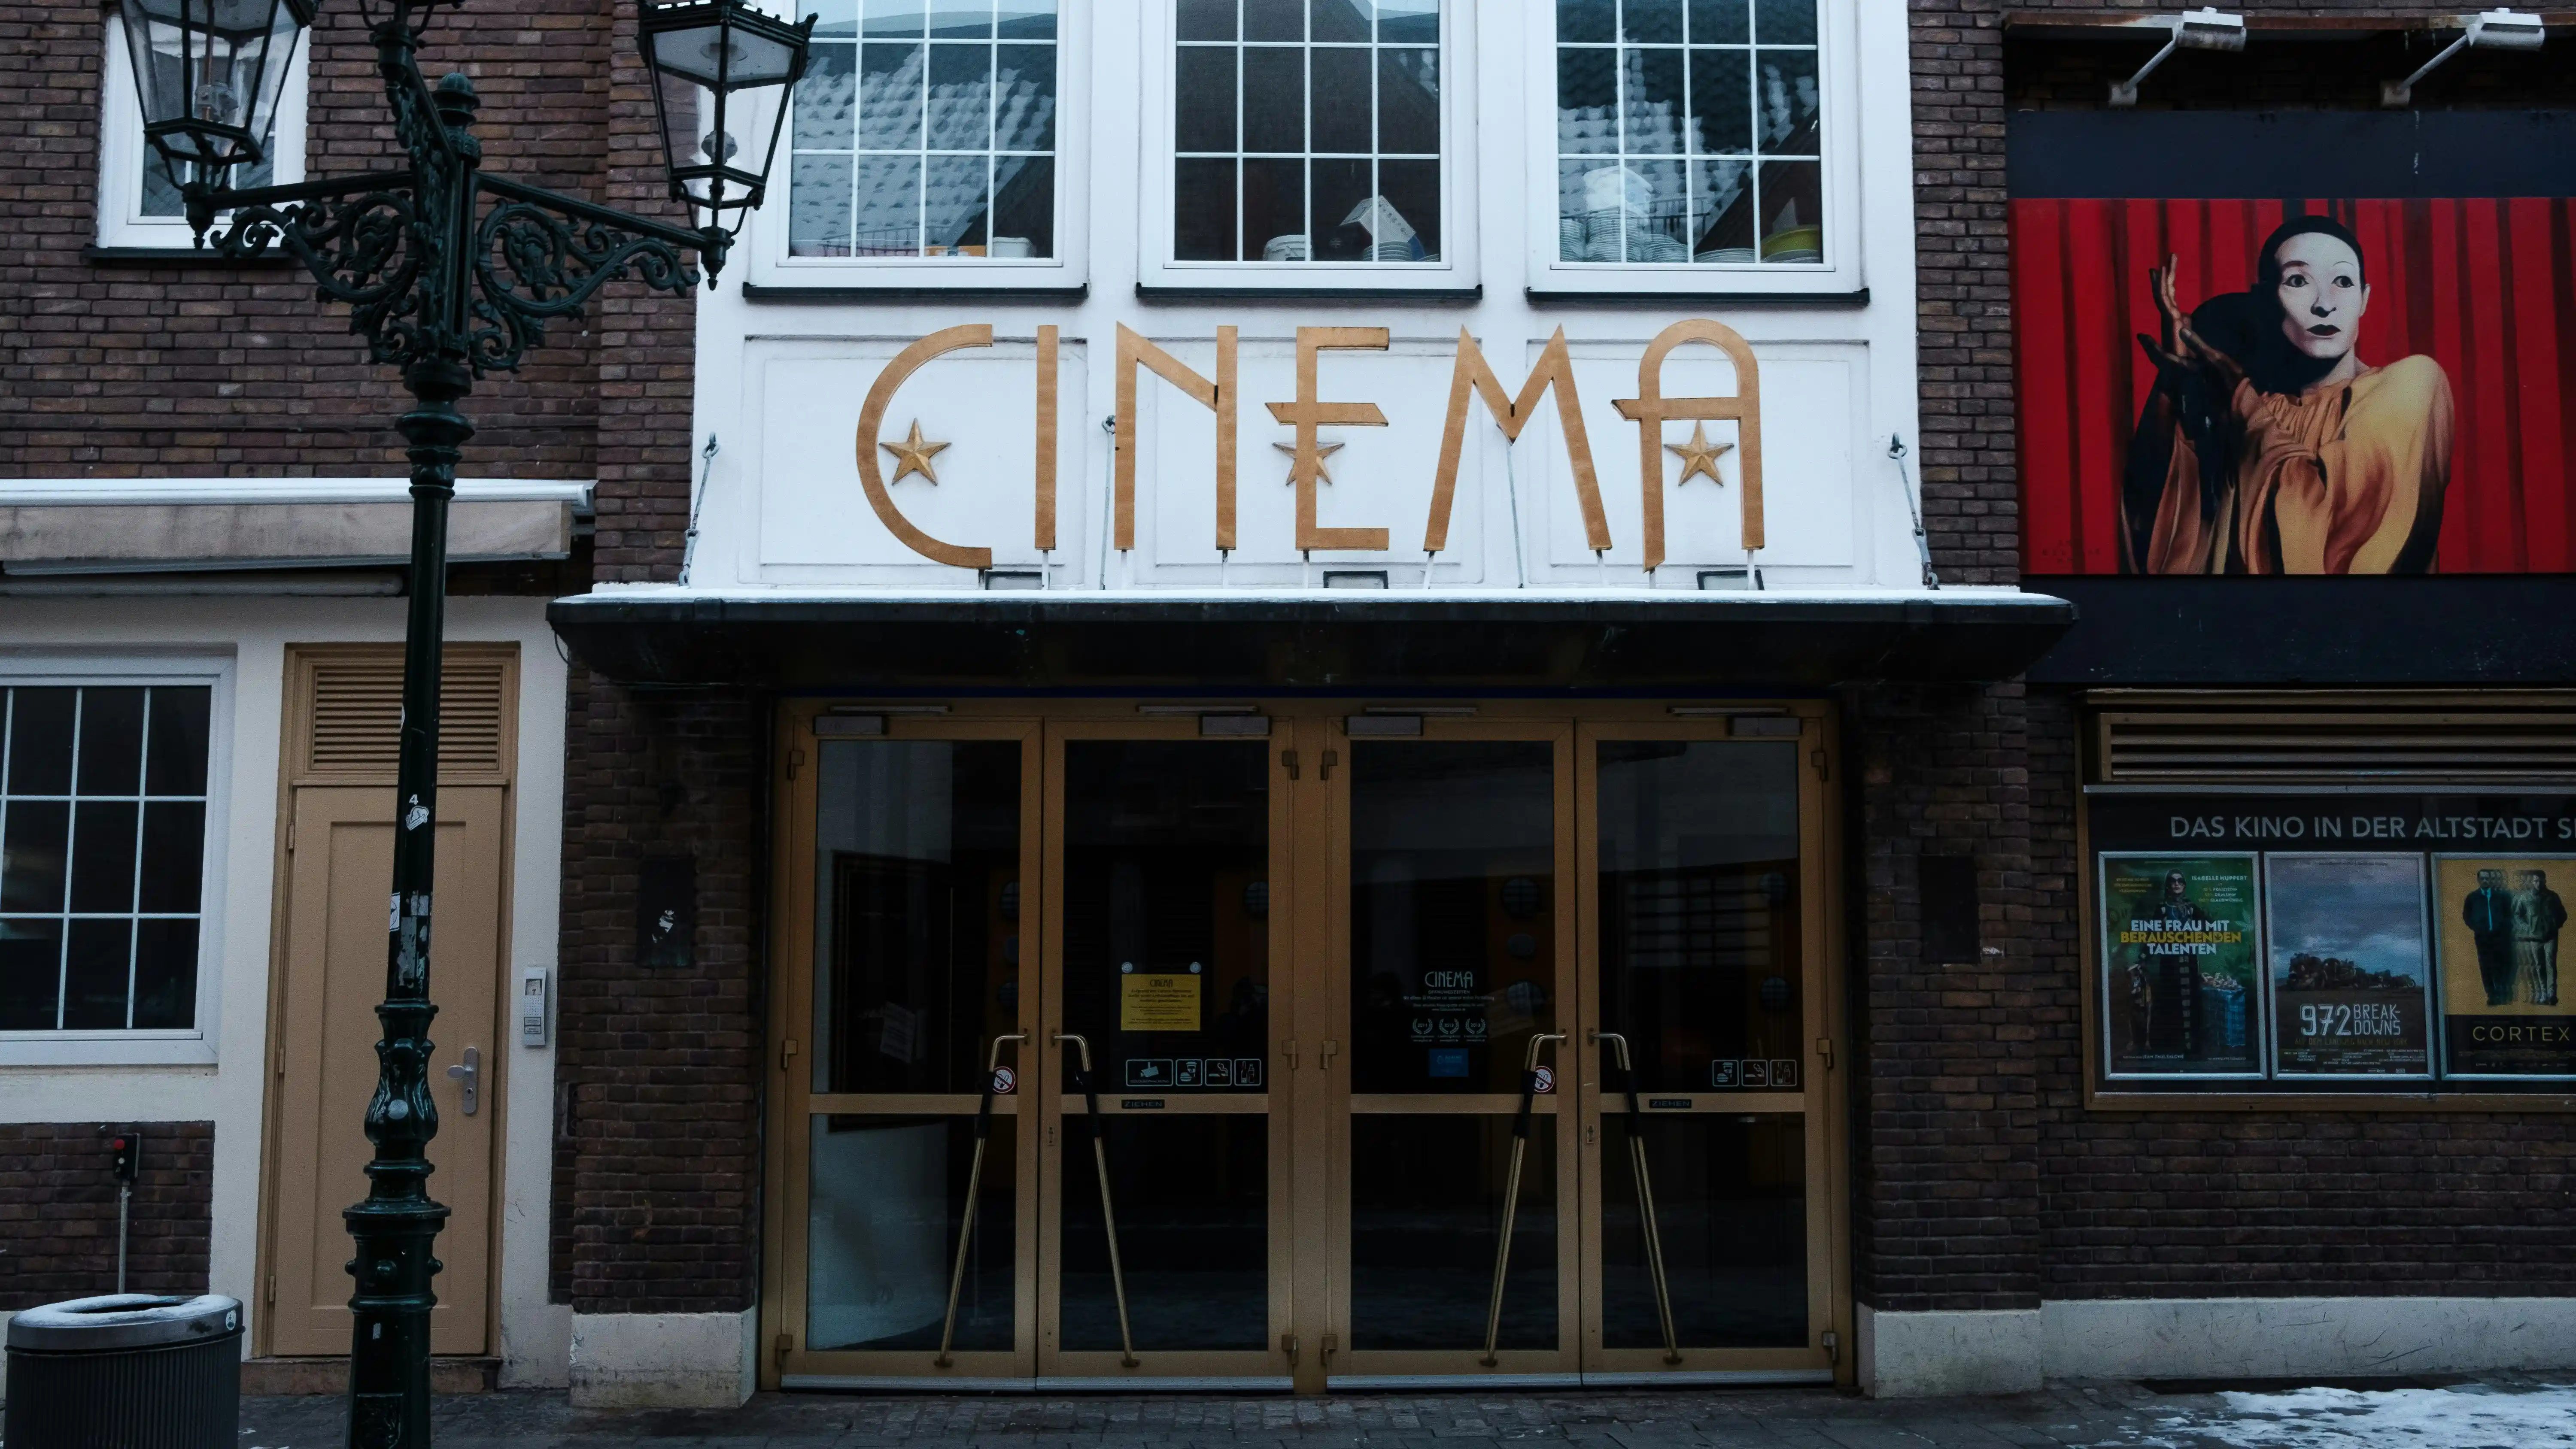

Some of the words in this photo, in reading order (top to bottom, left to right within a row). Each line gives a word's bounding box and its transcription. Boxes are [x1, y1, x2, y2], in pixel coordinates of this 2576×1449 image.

[858, 320, 1765, 571] CINEMA
[408, 794, 419, 805] 4
[2171, 817, 2225, 838] DAS
[2235, 817, 2304, 838] KINO
[2314, 817, 2342, 838] IN
[2352, 817, 2406, 838] DER
[2415, 817, 2549, 839] ALTSTADT
[2557, 817, 2576, 839] S
[2131, 920, 2162, 931] EINE
[2165, 920, 2202, 931] FRAU
[2205, 920, 2230, 931] MIT
[2120, 931, 2242, 943] BERAUSCHENDEN
[2147, 943, 2216, 955] TALENTEN
[1425, 970, 1473, 989] CINEMA
[2353, 1003, 2401, 1019] BREAK-
[2300, 1003, 2352, 1036] 972
[2354, 1020, 2401, 1036] DOWNS
[2473, 1026, 2570, 1041] CORTEX
